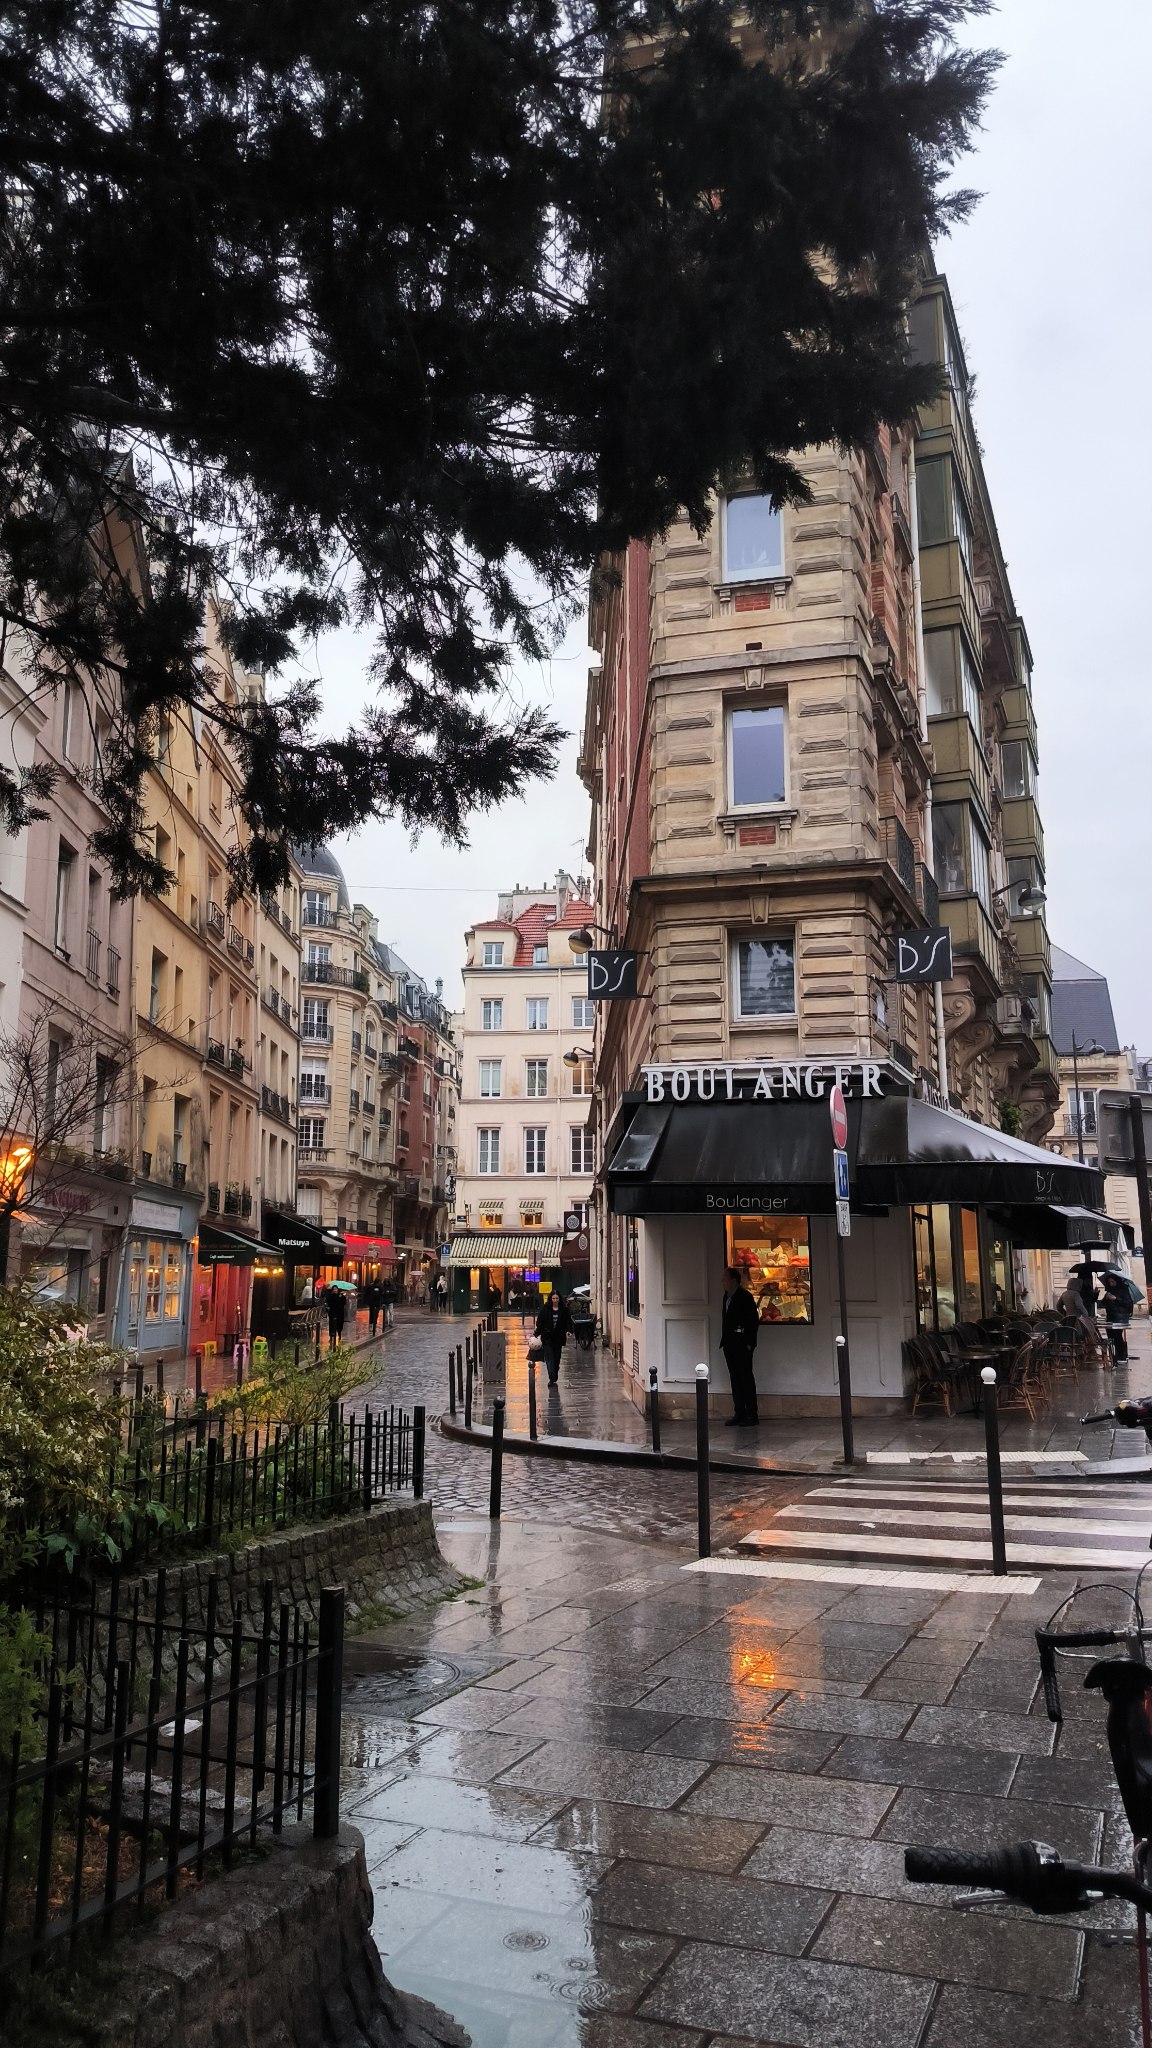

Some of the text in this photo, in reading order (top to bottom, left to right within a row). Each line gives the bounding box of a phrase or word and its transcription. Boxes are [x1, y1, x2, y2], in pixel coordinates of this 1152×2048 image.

[646, 1065, 885, 1102] BOULANGER
[706, 1194, 789, 1212] Boulanger
[278, 1238, 310, 1248] Matsuya
